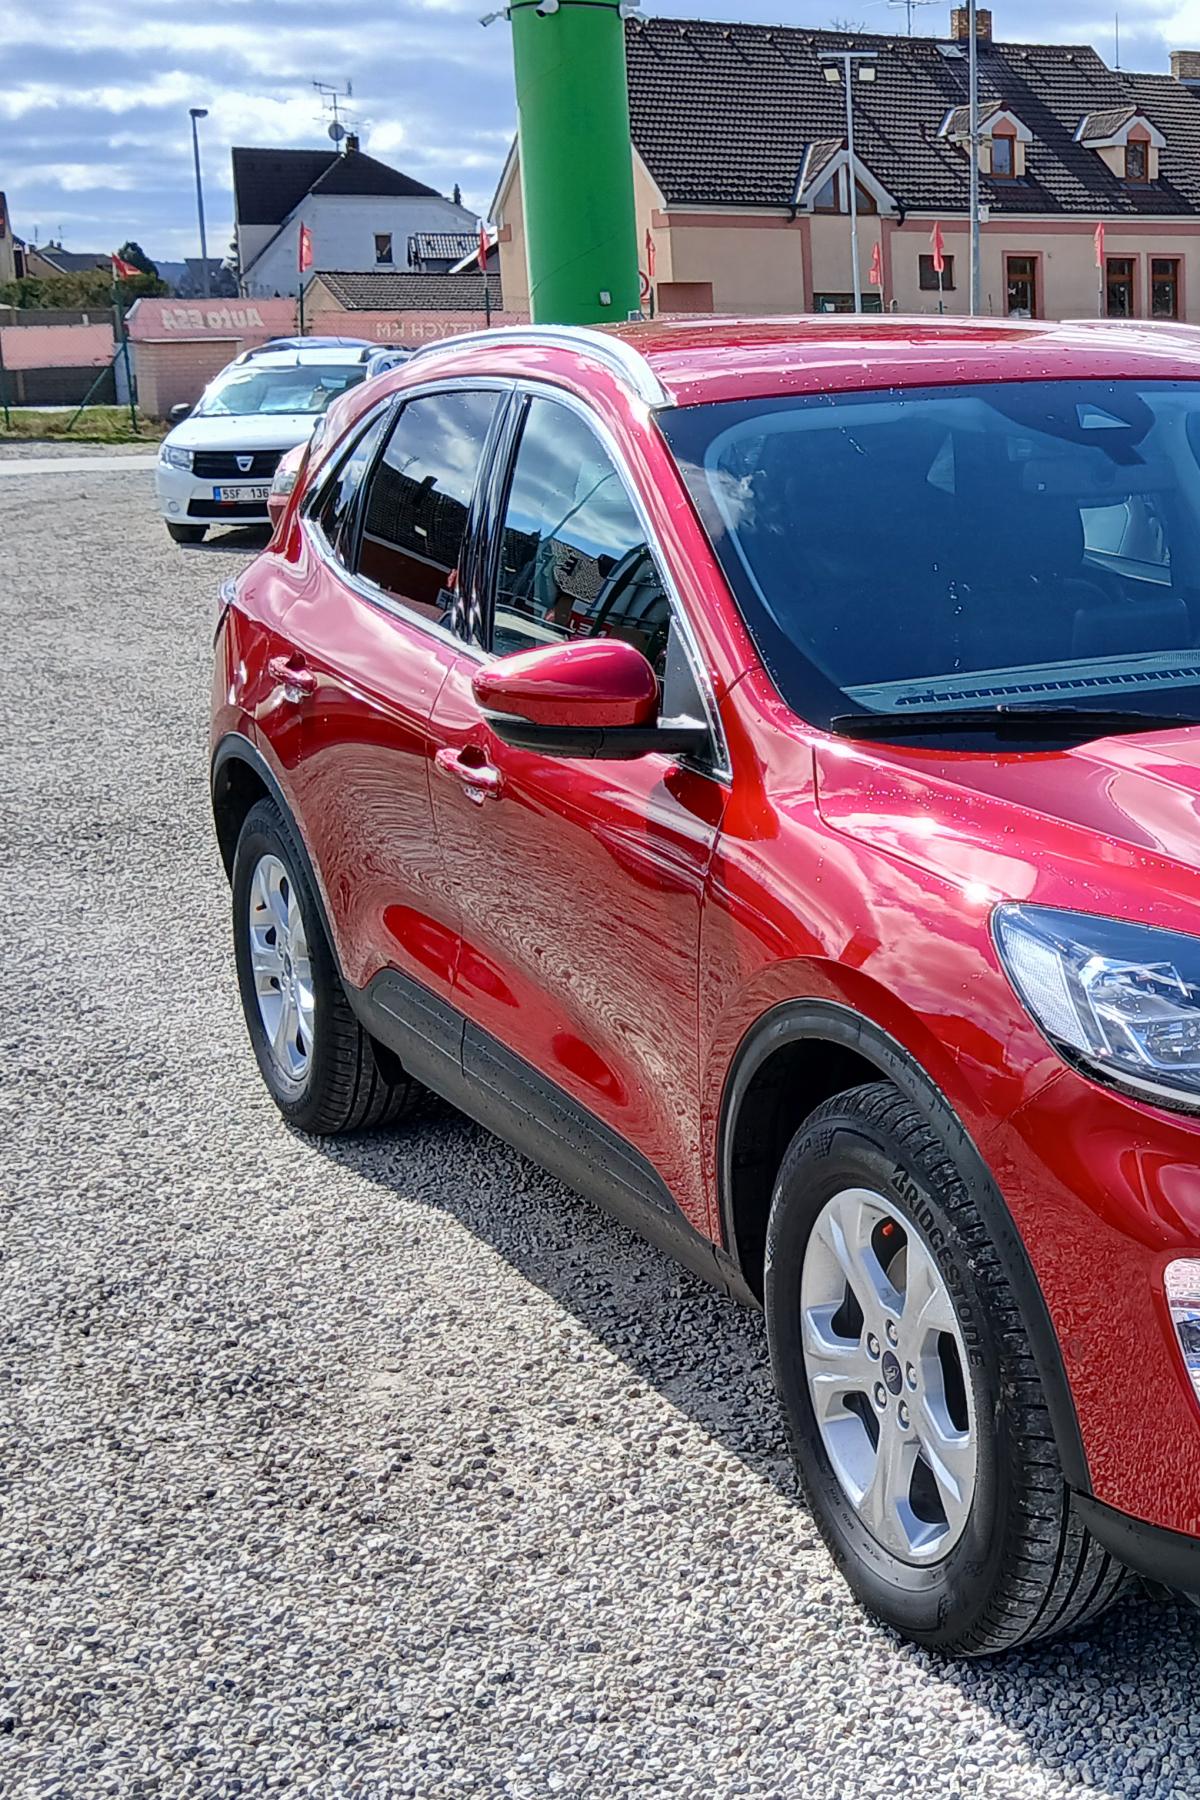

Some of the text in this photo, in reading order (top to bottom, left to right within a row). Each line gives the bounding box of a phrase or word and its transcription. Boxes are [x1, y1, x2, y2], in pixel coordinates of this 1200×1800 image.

[223, 487, 270, 499] 5SF 136
[889, 1163, 985, 1368] BRIDGESTONE
